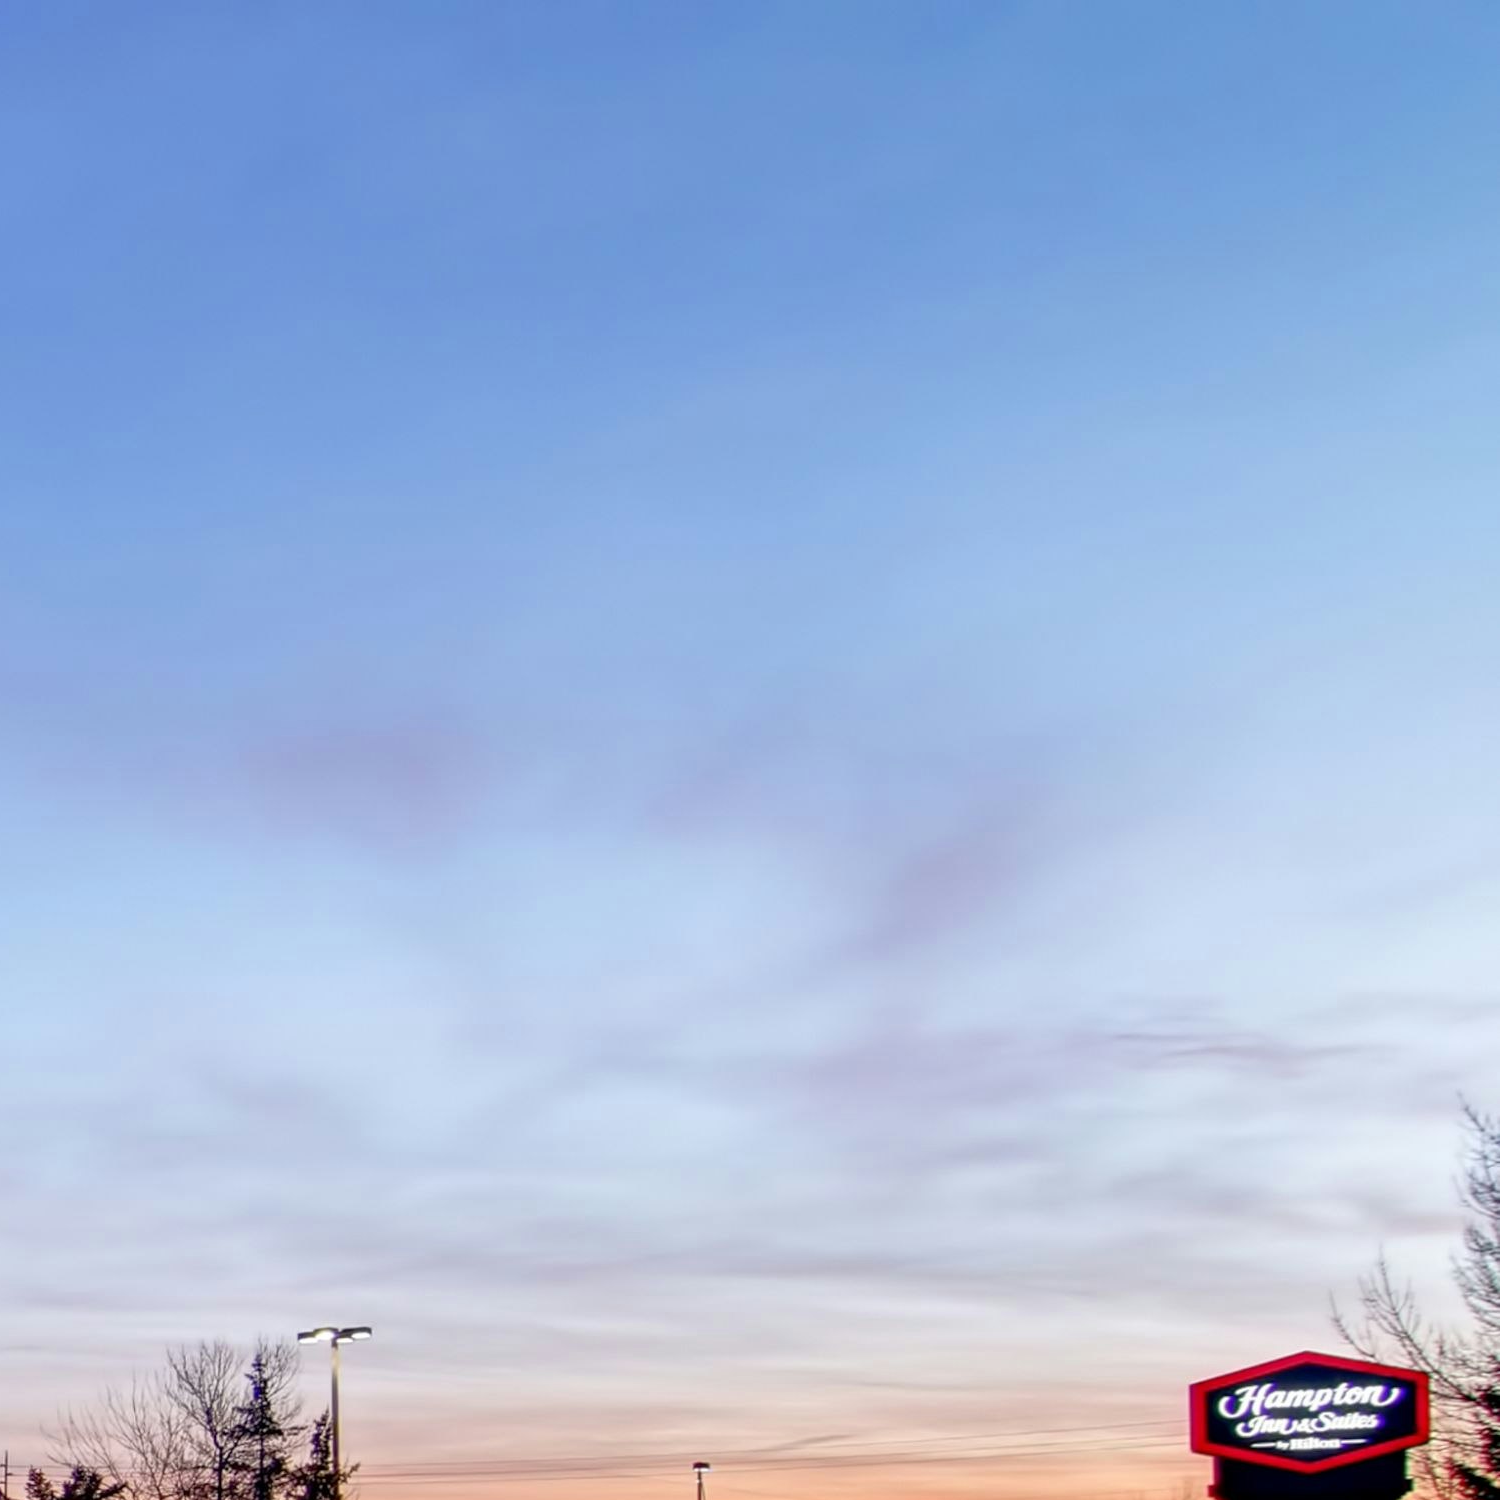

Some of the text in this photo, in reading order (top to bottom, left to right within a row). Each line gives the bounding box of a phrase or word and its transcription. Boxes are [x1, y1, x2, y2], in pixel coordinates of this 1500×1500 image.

[1218, 1382, 1400, 1419] Hampton
[1235, 1415, 1298, 1437] Inn
[1311, 1412, 1378, 1432] Suites
[1290, 1437, 1342, 1450] Hilton
